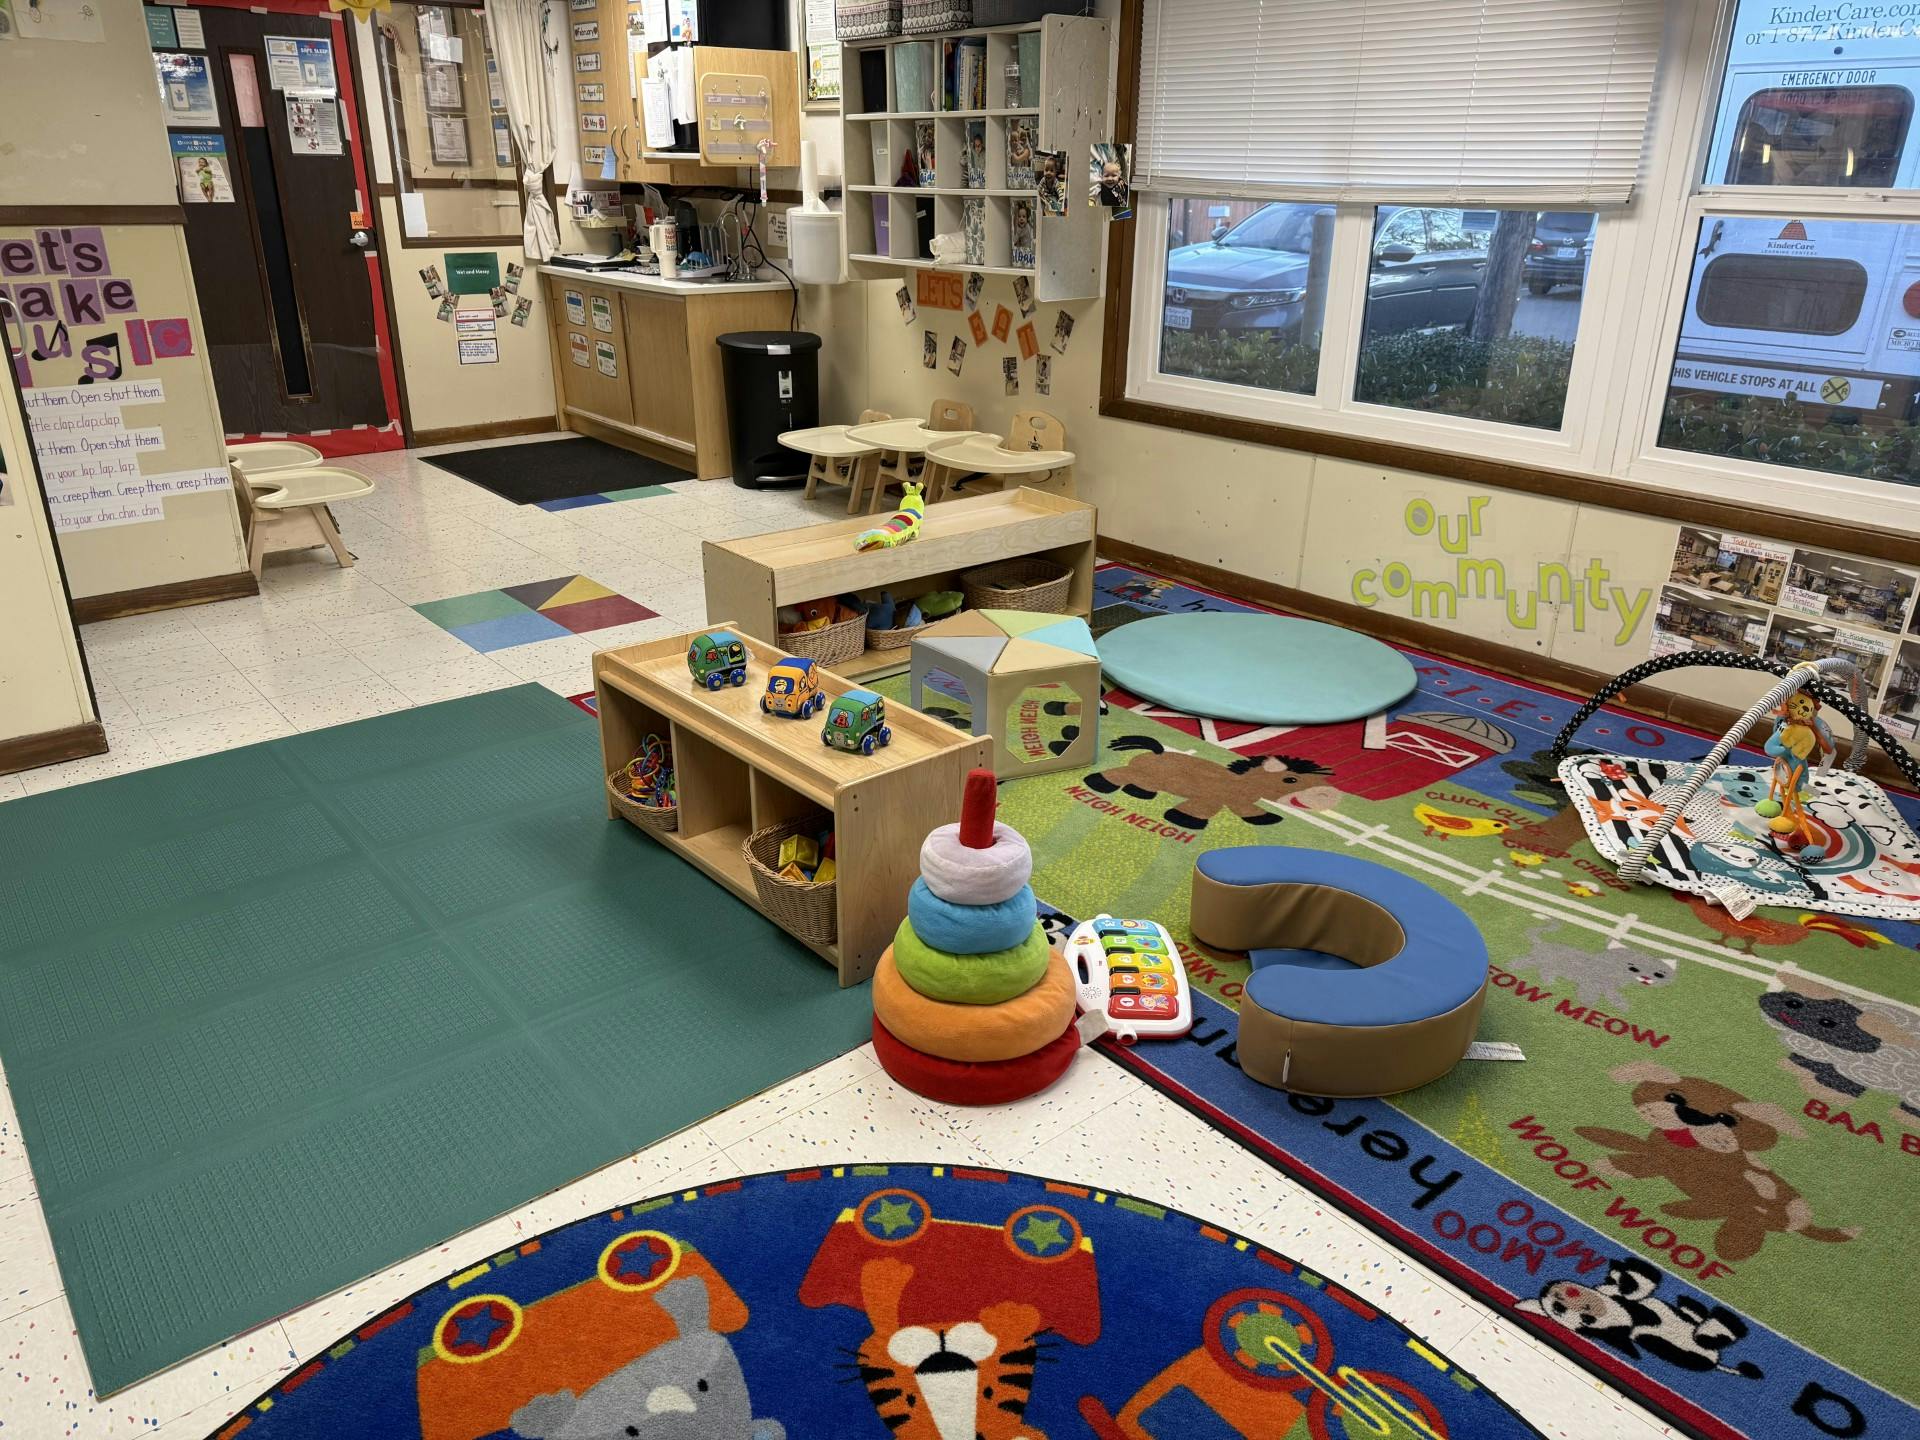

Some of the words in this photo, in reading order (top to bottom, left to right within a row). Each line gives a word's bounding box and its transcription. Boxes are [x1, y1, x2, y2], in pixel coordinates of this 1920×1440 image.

[1745, 33, 1762, 45] or
[1769, 18, 1920, 45] 1-877-KinderC
[1781, 71, 1844, 86] EMERGENCY
[1846, 70, 1876, 84] DOOR
[0, 228, 103, 273] et's
[1767, 241, 1815, 250] KinderCare
[1673, 367, 1691, 379] HIS
[1694, 369, 1737, 384] VEHICLE
[1739, 374, 1776, 388] STOPS
[1777, 378, 1793, 390] AT
[1794, 380, 1816, 393] ALL
[71, 389, 101, 407] Open
[104, 386, 132, 401] shut
[80, 438, 109, 454] Open
[109, 435, 131, 449] shut
[57, 470, 78, 483] your
[63, 492, 89, 504] creep
[117, 483, 145, 497] Creep
[176, 478, 201, 490] creep
[73, 516, 93, 529] your
[1405, 495, 1491, 554] our
[1352, 558, 1652, 646] community
[1063, 785, 1123, 816] NEIGH
[1122, 811, 1195, 844] NEIGH
[1425, 791, 1489, 811] CLUCK
[1572, 858, 1632, 892] CHEEP
[1489, 965, 1552, 1003] EOW
[1554, 999, 1670, 1049] MEOW
[1803, 1098, 1885, 1144] BAA
[1507, 1115, 1611, 1193] WOOF
[1603, 1196, 1736, 1281] WOOF
[1432, 1210, 1546, 1275] MOO
[1497, 1199, 1607, 1274] MOO
